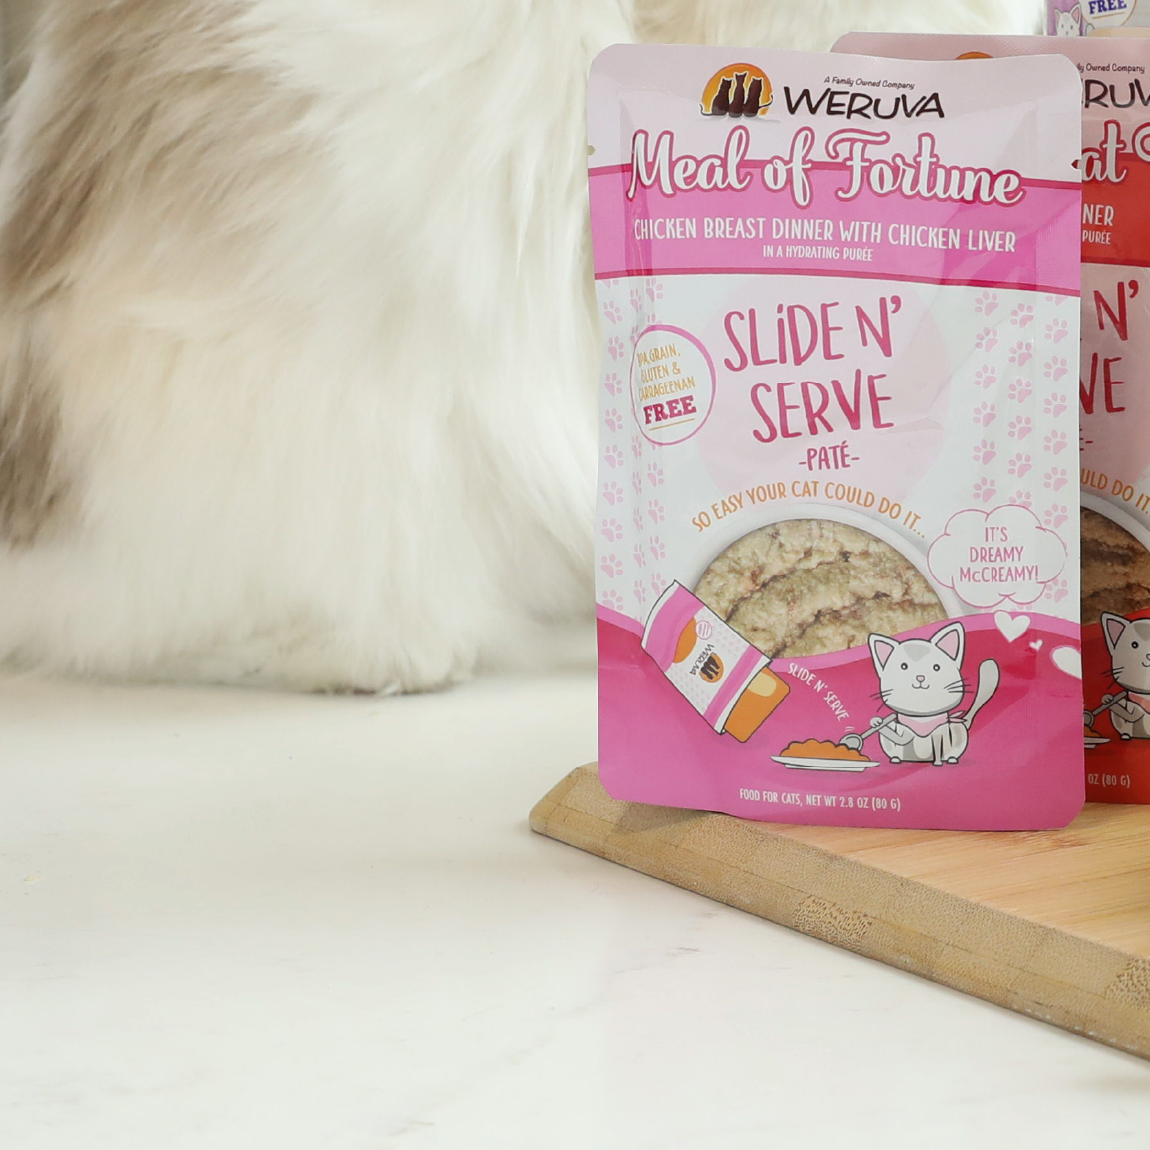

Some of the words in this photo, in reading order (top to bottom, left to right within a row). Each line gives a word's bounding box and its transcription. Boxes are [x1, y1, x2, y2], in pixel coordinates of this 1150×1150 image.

[1086, 63, 1111, 72] Owned
[1112, 64, 1145, 74] Company
[832, 76, 854, 88] Family
[855, 77, 881, 87] Owned
[882, 79, 915, 90] Company
[783, 86, 945, 120] WERUVA
[625, 125, 750, 201] Meal
[763, 127, 814, 209] of
[825, 127, 1023, 205] Fortune
[633, 217, 697, 240] CHICKEN
[703, 217, 765, 240] BREAST
[772, 217, 833, 242] DINNER
[839, 220, 882, 244] WITH
[888, 223, 961, 250] CHICKEN
[968, 228, 1016, 253] LIVER
[763, 245, 772, 258] IN
[774, 245, 784, 258] A
[785, 245, 840, 260] HYDRATING
[842, 245, 873, 262] PURÉE
[641, 364, 669, 383] GLUTEN
[643, 395, 697, 424] FREE
[750, 368, 894, 444] SERVE
[1111, 480, 1134, 503] DO
[692, 510, 711, 533] SO
[711, 492, 744, 520] EASY
[746, 481, 787, 505] YOUR
[791, 480, 819, 498] CAT
[824, 481, 875, 508] COULD
[877, 496, 901, 520] DO
[984, 526, 1008, 543] IT'S
[969, 546, 1024, 564] DREAMY
[959, 565, 1040, 584] McCREAMY!
[787, 662, 816, 686] SLIDE
[823, 691, 849, 722] SERVE
[739, 788, 760, 801] FOOD
[762, 790, 779, 803] FOR
[781, 792, 803, 807] CATS,
[805, 793, 822, 806] NET
[823, 794, 837, 807] WT
[839, 796, 854, 808] 2.8
[857, 797, 869, 809] OZ
[871, 796, 887, 811] (80
[890, 797, 901, 812] G)
